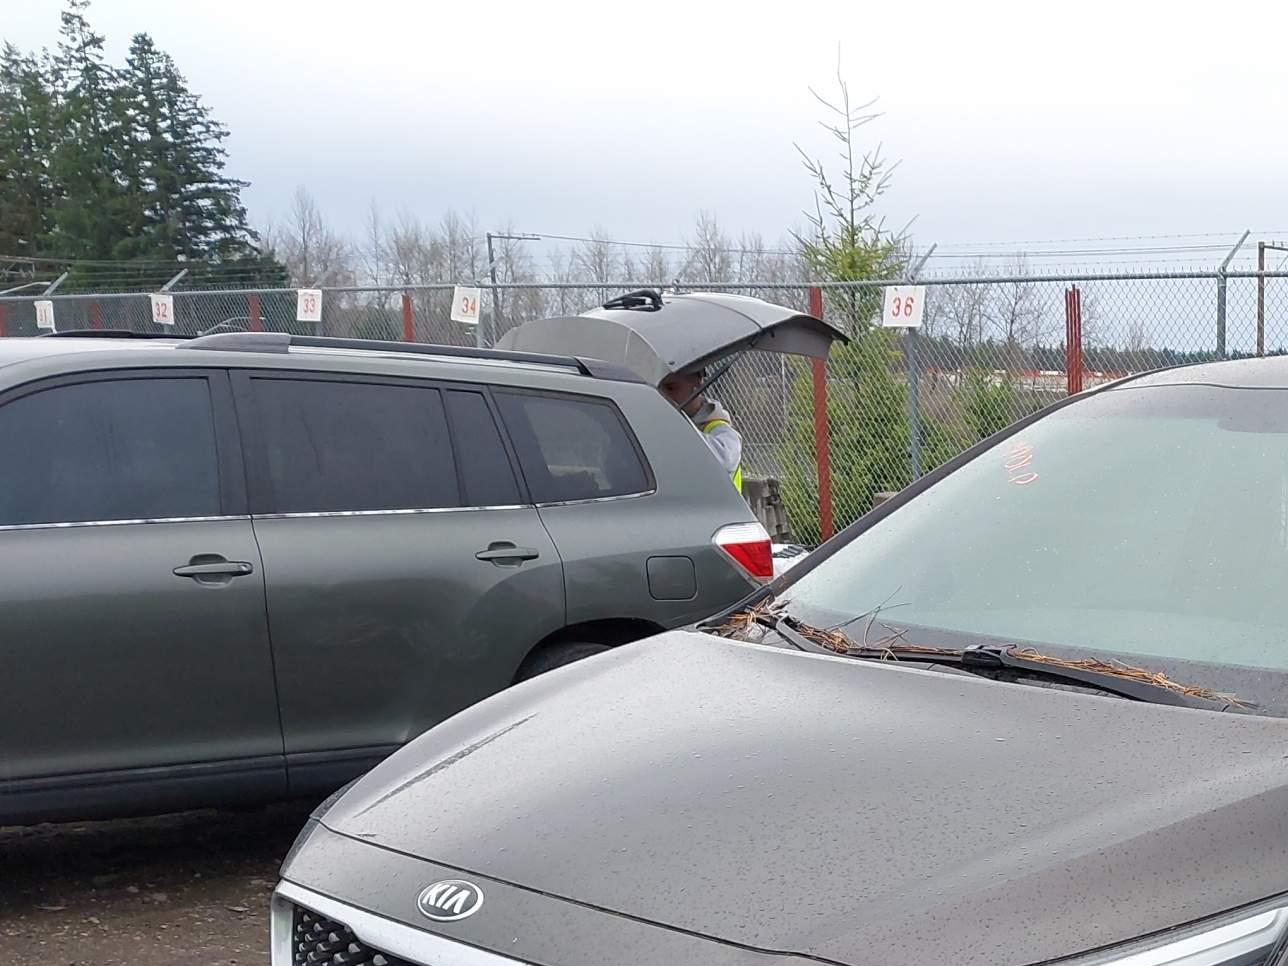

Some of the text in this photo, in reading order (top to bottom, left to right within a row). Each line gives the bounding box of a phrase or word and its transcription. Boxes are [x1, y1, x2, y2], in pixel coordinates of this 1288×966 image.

[155, 302, 168, 318] 32
[303, 298, 316, 313] 33
[462, 297, 476, 315] 34
[892, 296, 914, 317] 36
[421, 883, 472, 915] KIA
